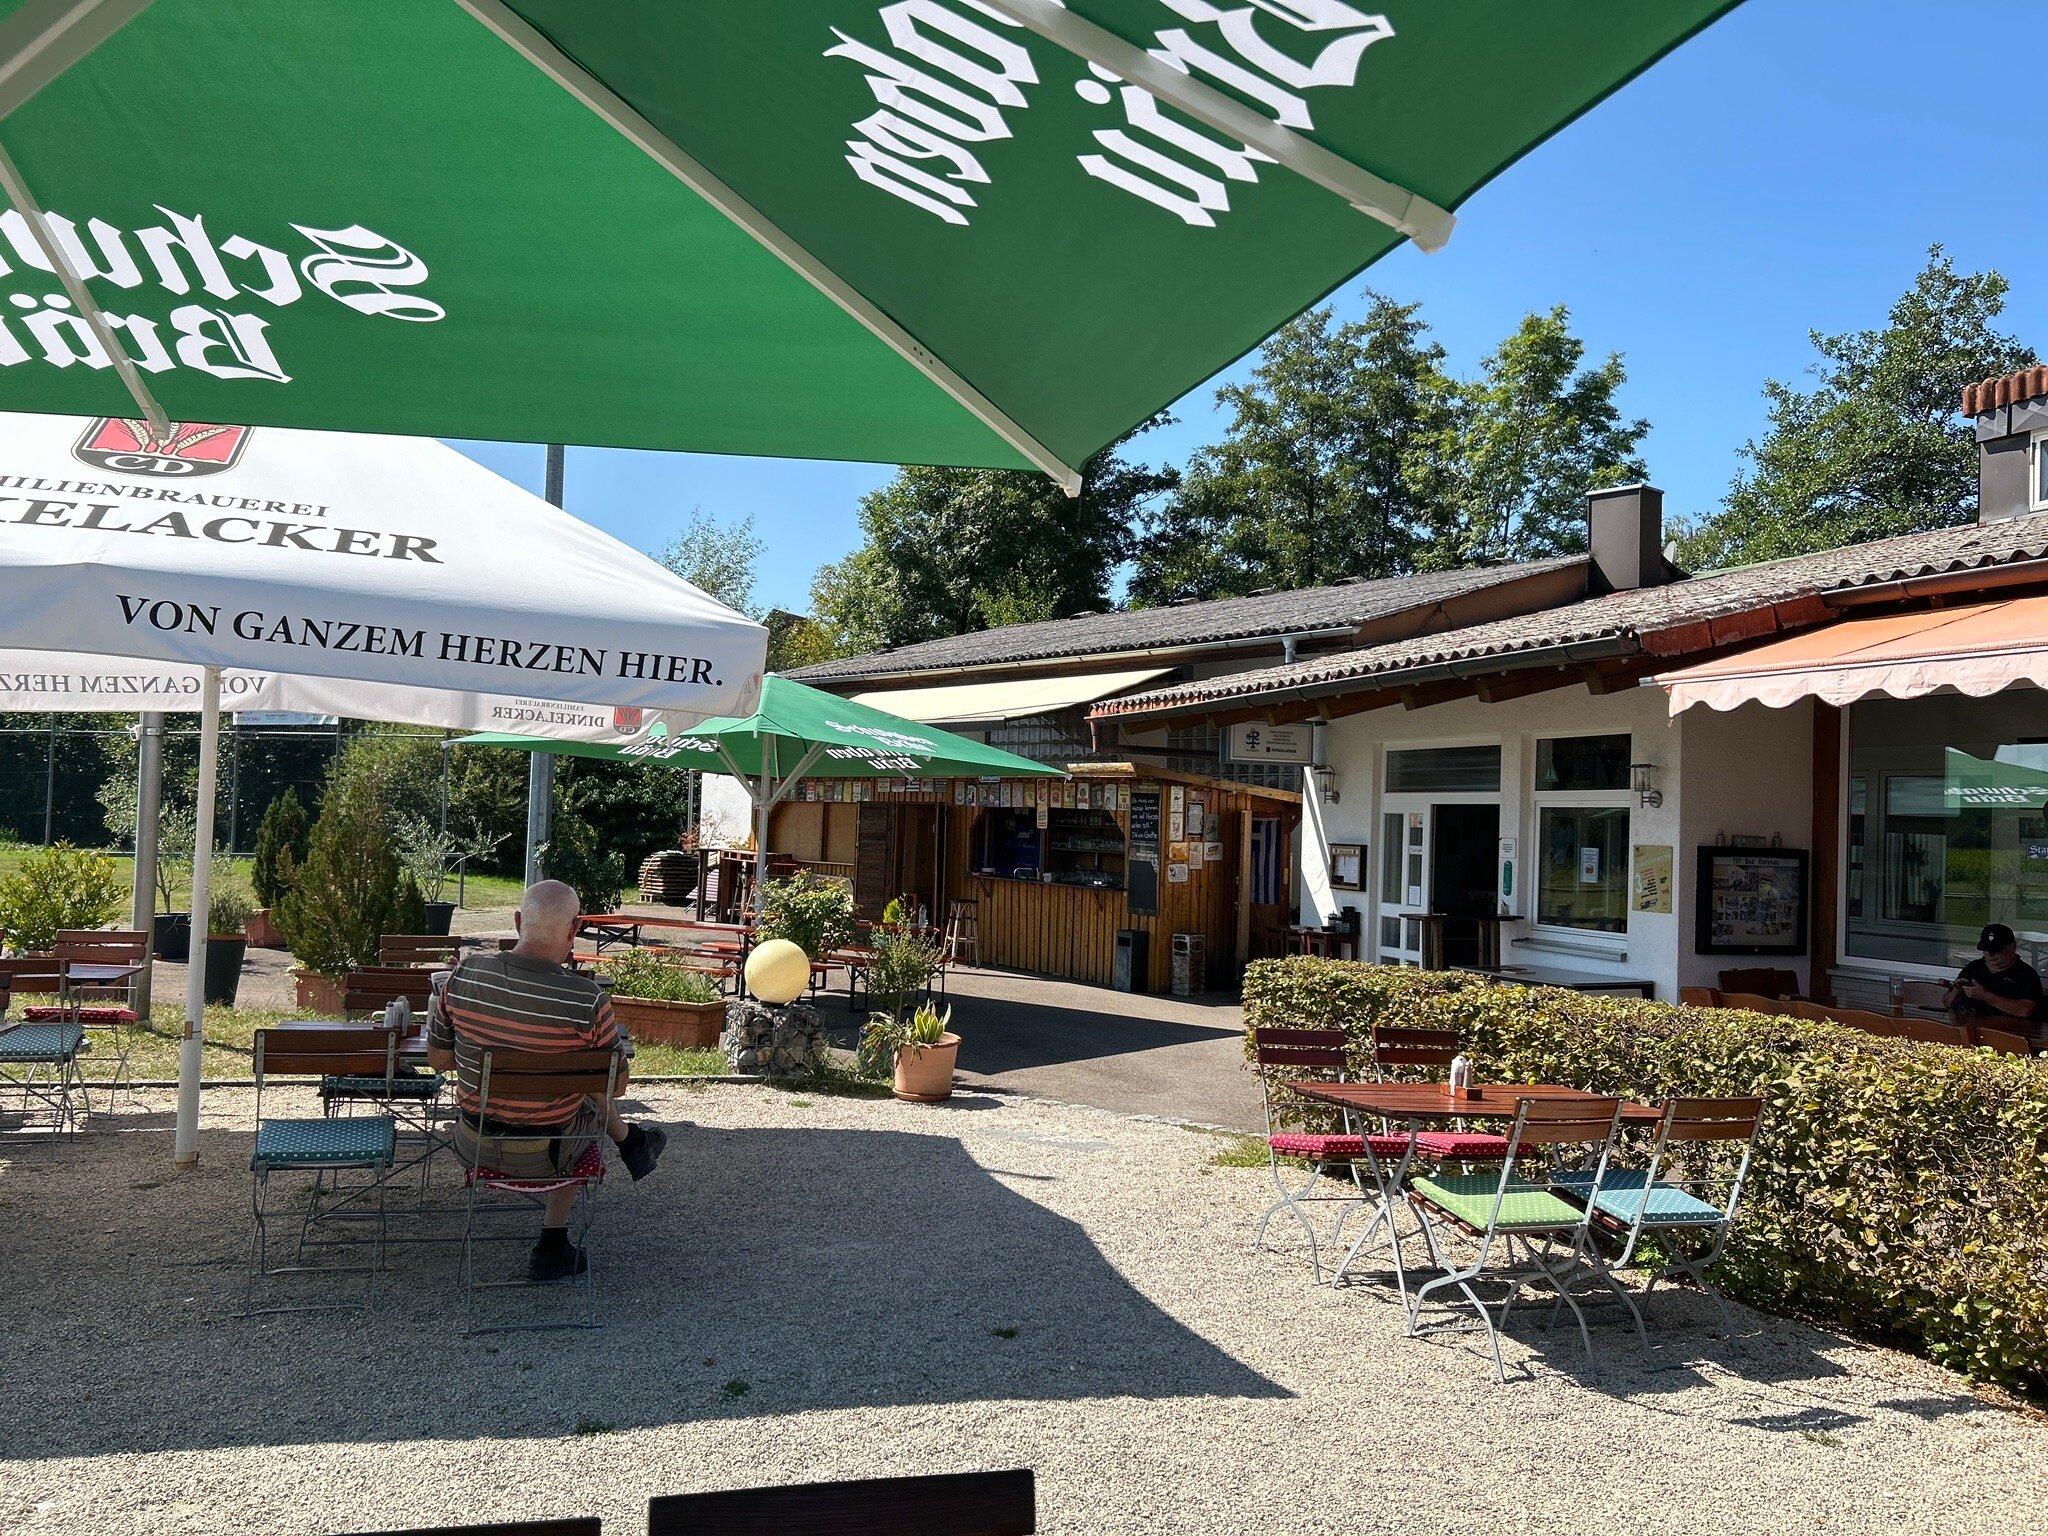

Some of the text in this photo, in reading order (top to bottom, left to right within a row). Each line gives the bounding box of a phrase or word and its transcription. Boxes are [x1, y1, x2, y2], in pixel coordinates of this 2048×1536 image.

[0, 496, 444, 564] ELACKER
[116, 592, 724, 687] VON GANZEM HERZEN HIER.
